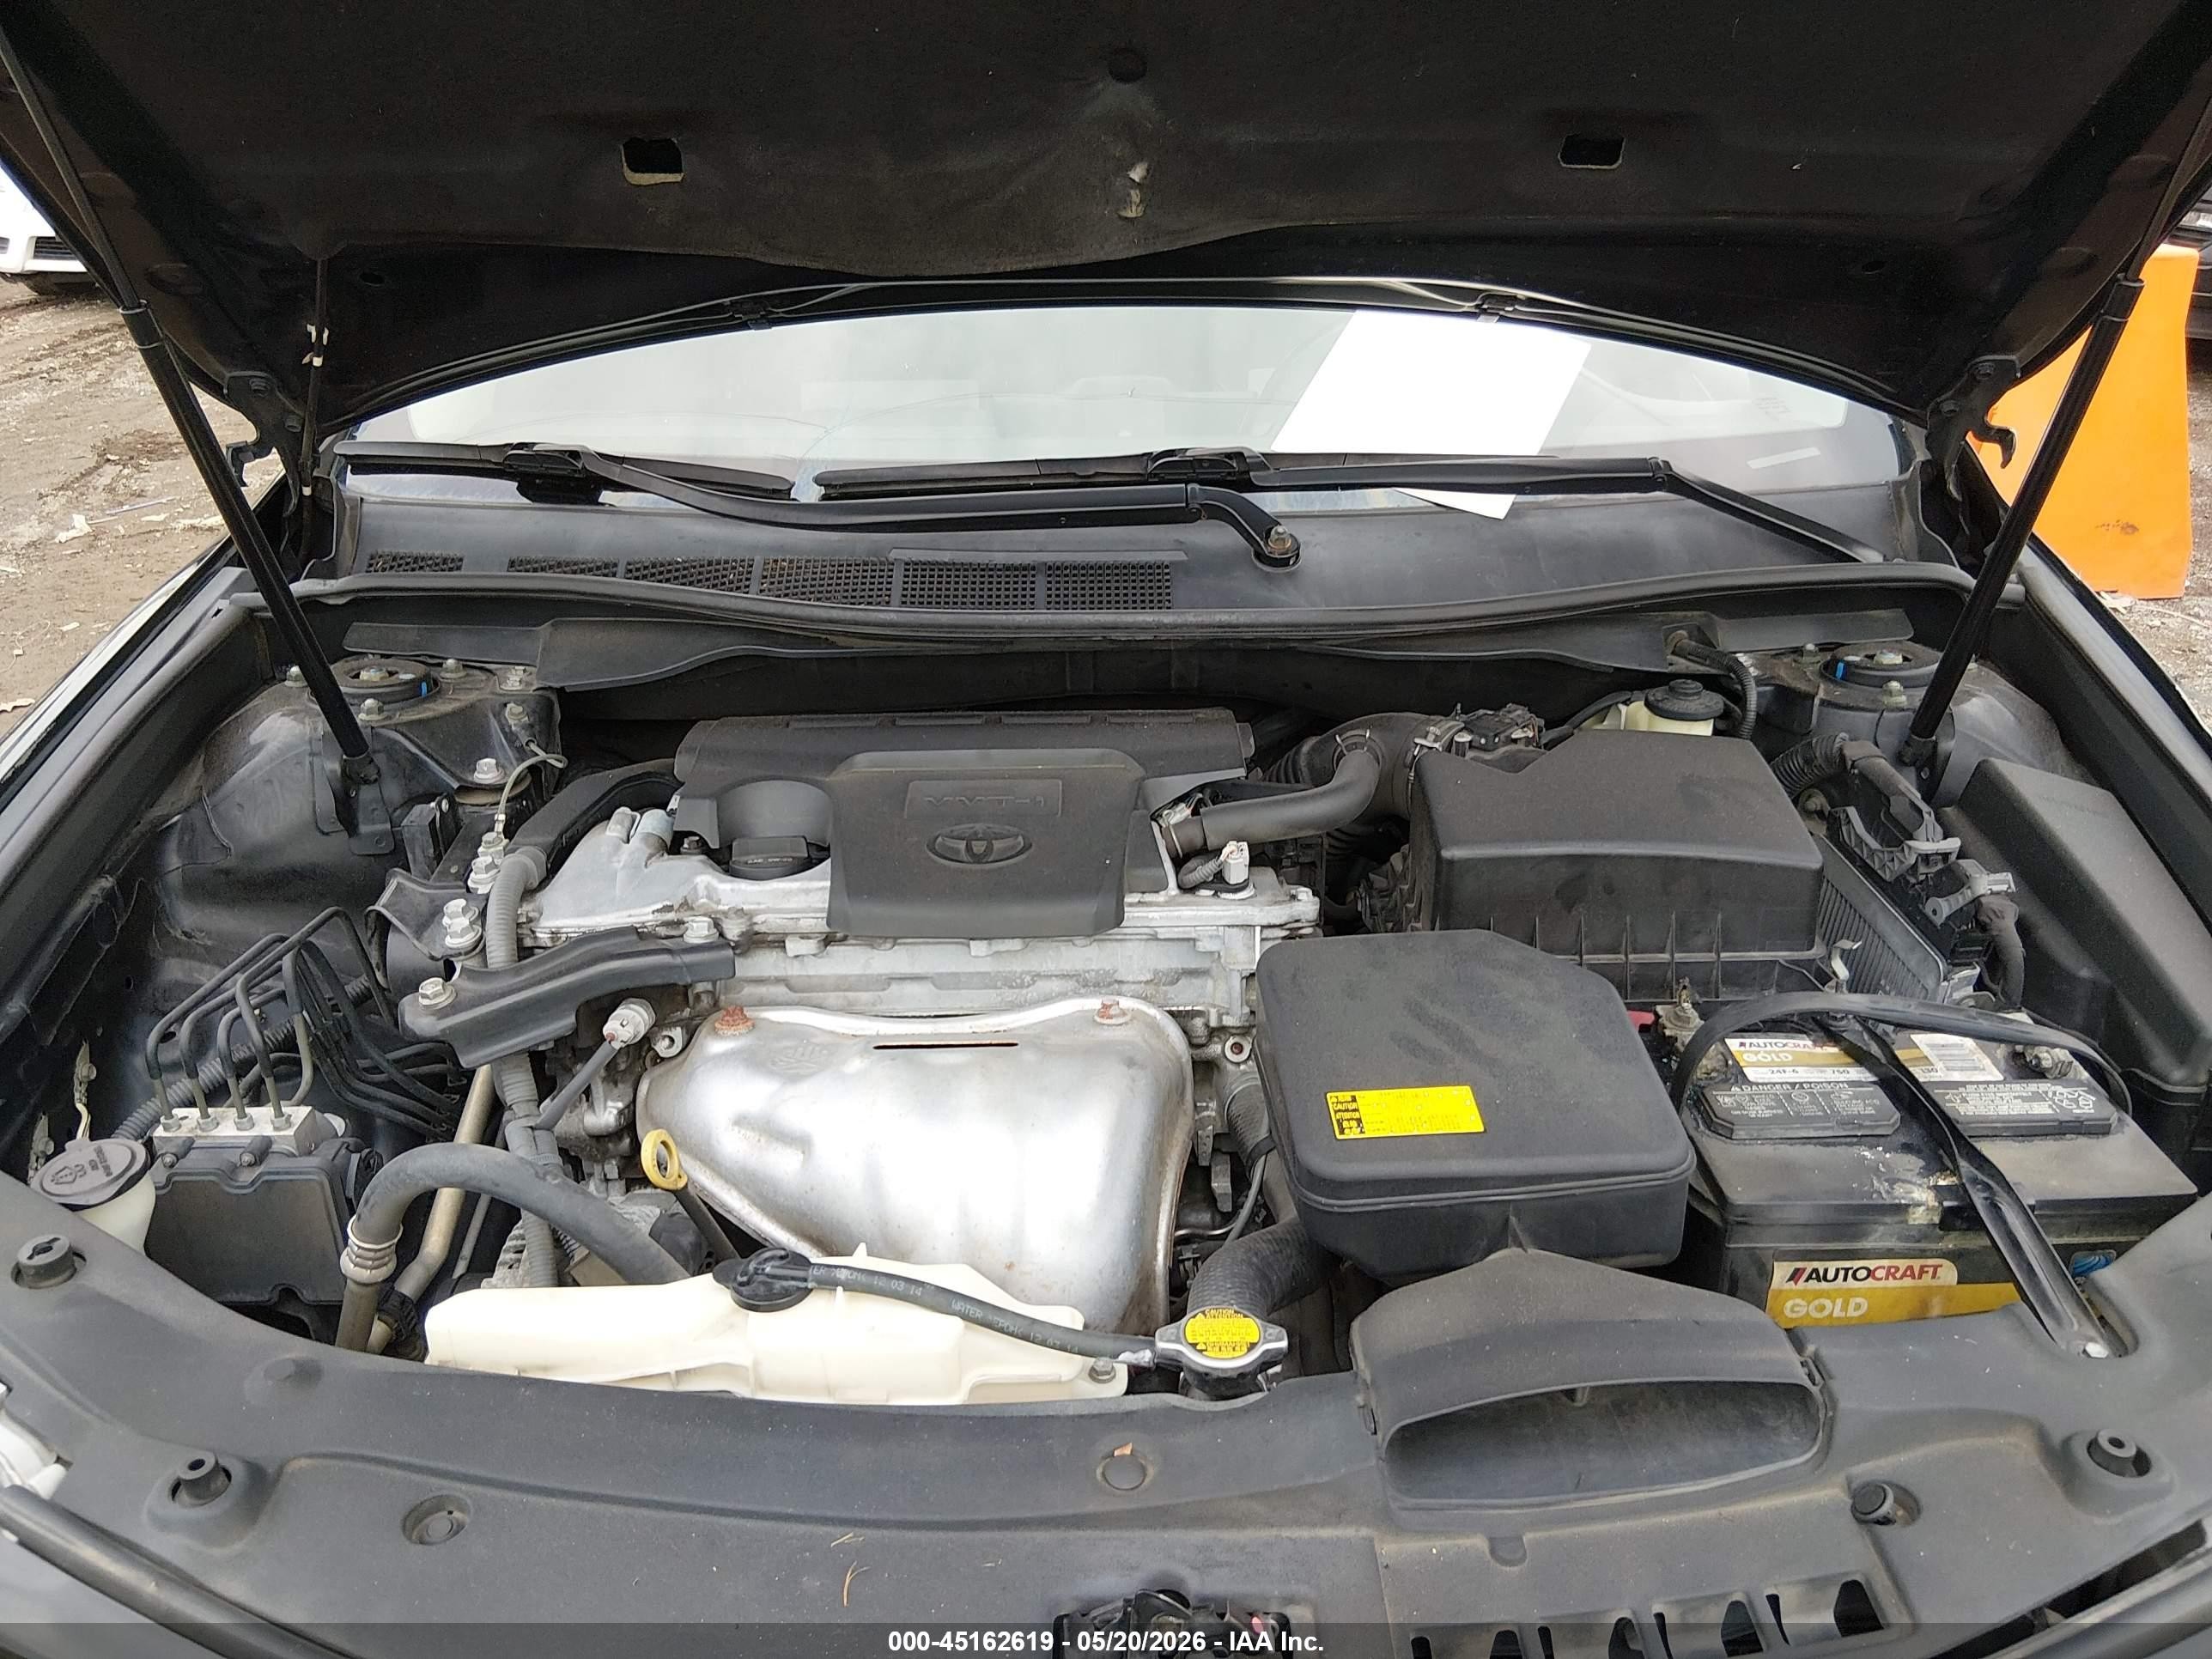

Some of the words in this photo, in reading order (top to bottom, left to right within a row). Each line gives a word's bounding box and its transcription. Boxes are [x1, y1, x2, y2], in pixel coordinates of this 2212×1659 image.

[1742, 1052, 1793, 1063] GOLD
[1333, 1102, 1358, 1110] CAUTION
[1803, 1263, 1943, 1284] AUTOCRAFT
[951, 1297, 983, 1320] WATER
[1784, 1297, 1869, 1319] GOLD
